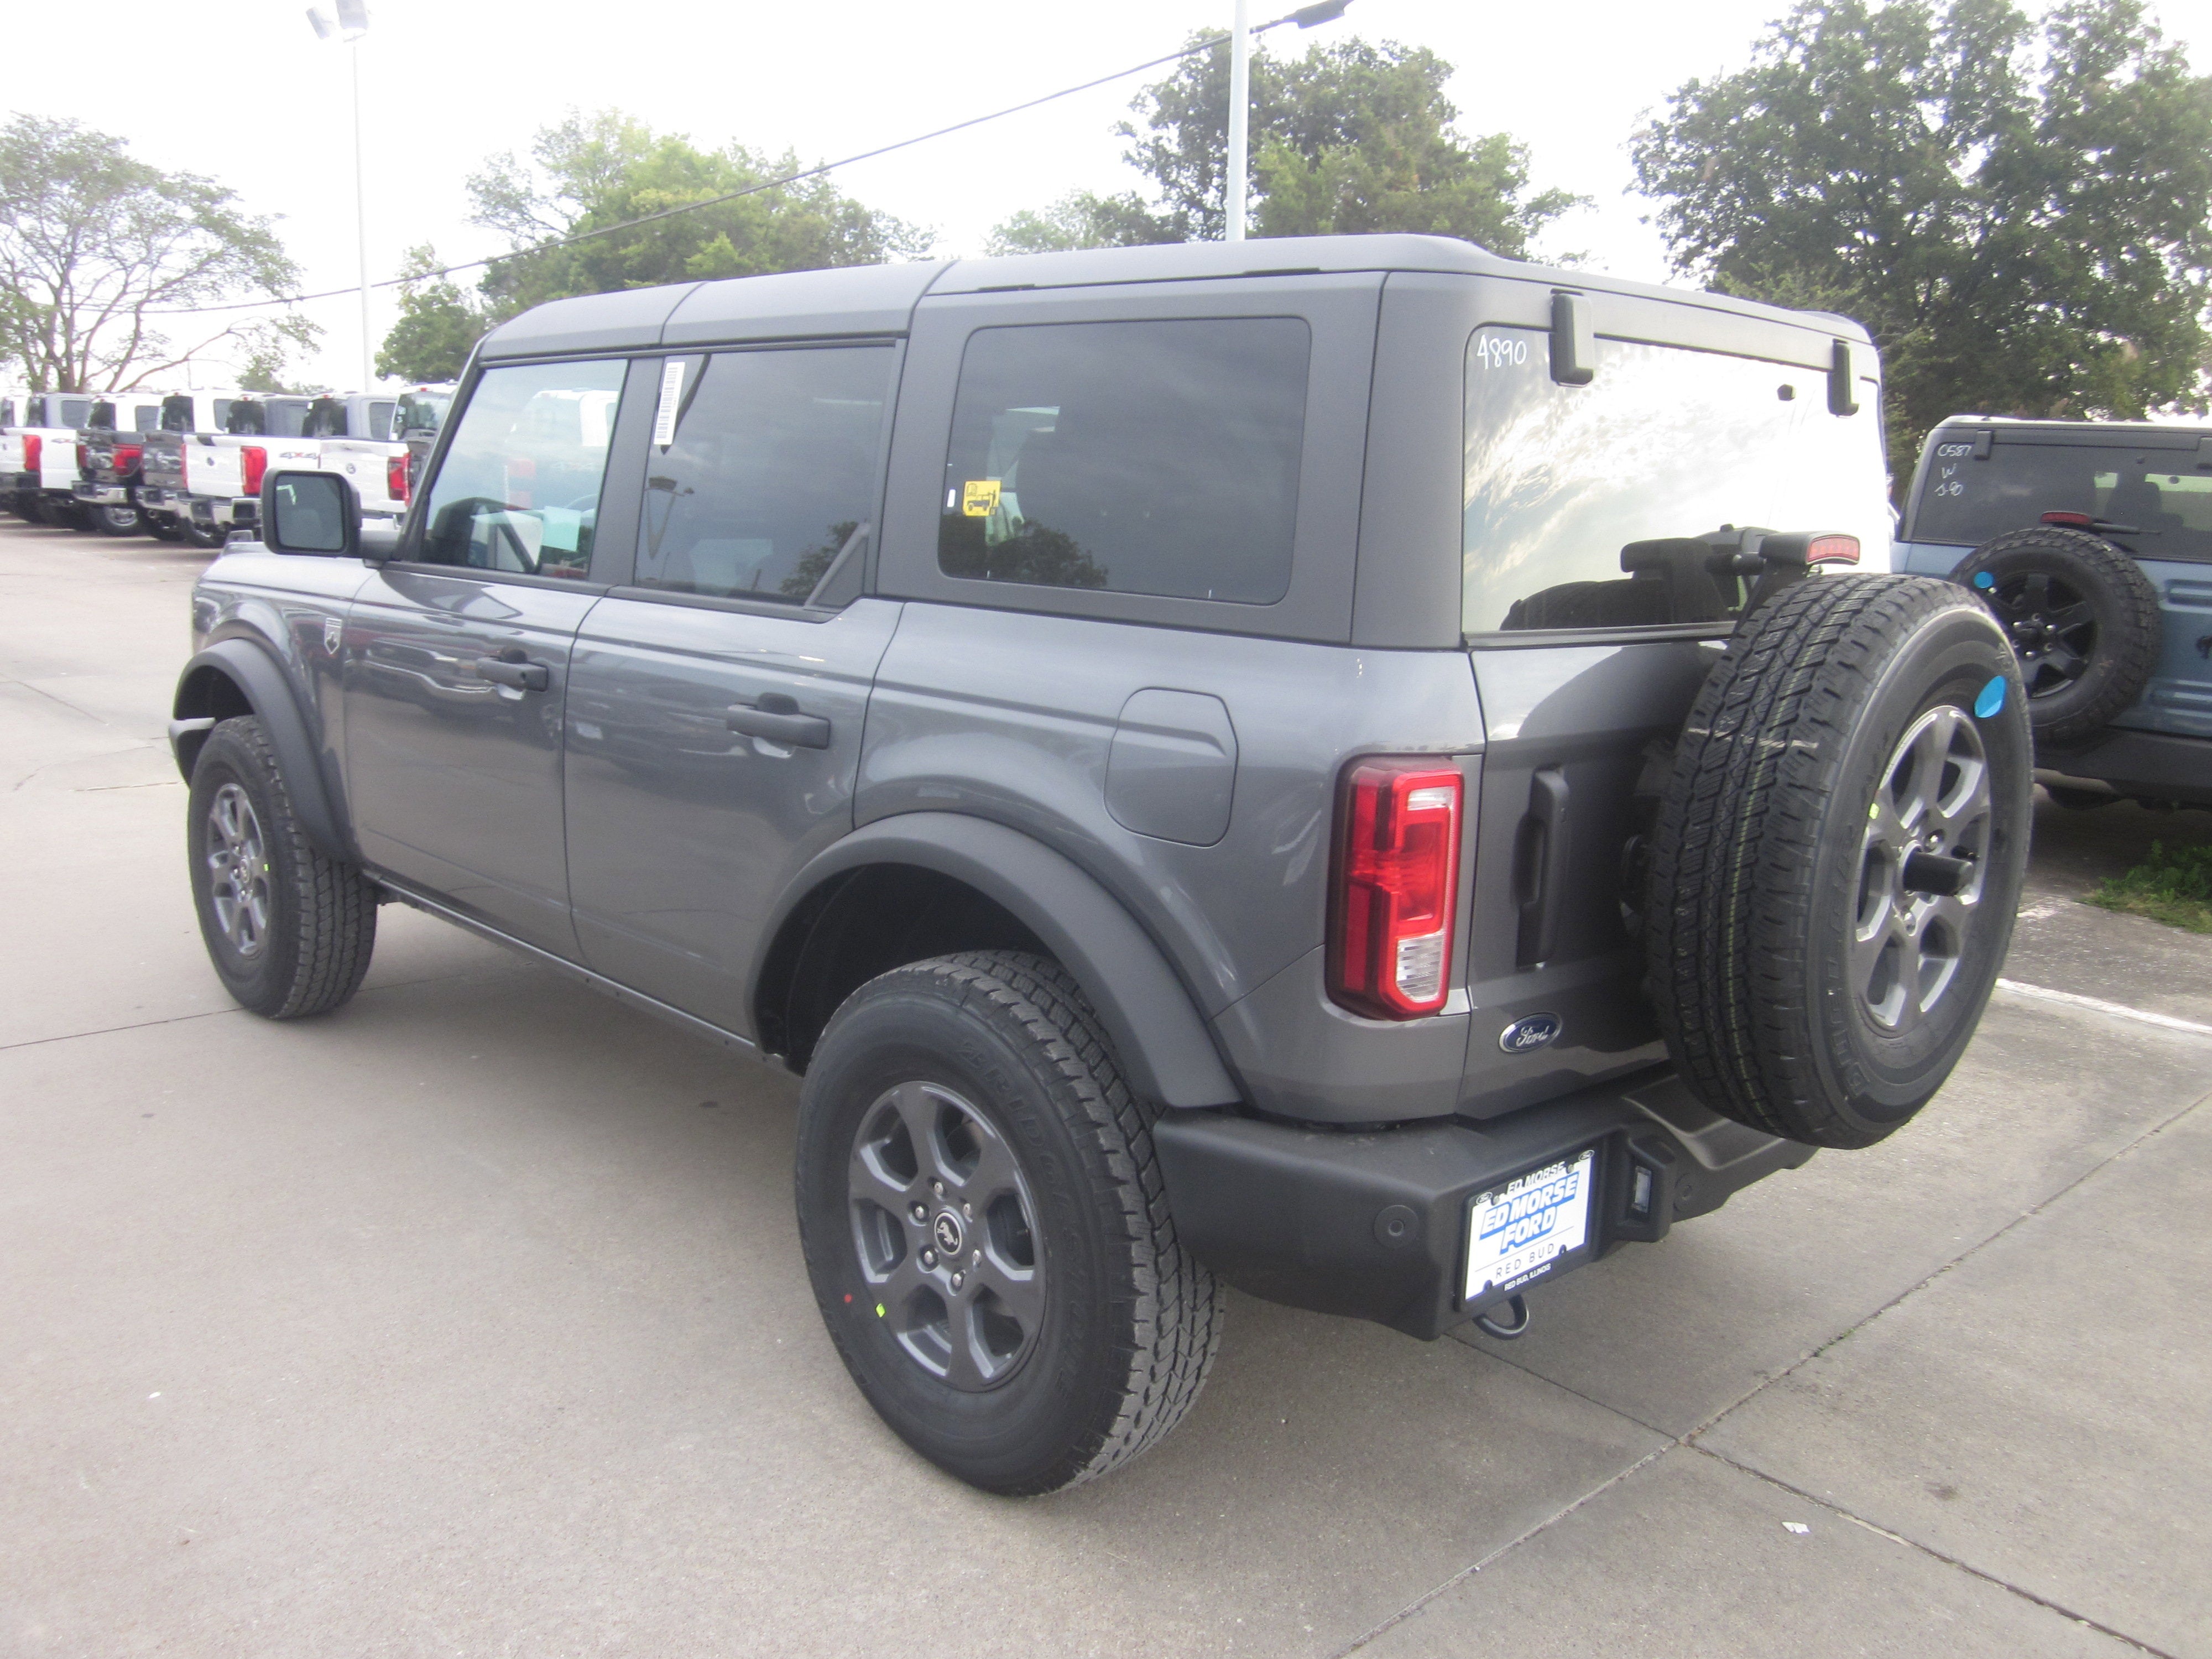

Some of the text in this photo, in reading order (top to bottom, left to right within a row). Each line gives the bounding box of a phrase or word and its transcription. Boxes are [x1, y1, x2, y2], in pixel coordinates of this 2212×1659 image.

[1477, 334, 1527, 370] 4890
[1516, 1025, 1550, 1047] Ford
[1507, 1161, 1566, 1194] ED MORSE
[1479, 1171, 1580, 1240] ED MORSE
[1499, 1206, 1558, 1255] FORD
[1495, 1243, 1555, 1279] RED BUD
